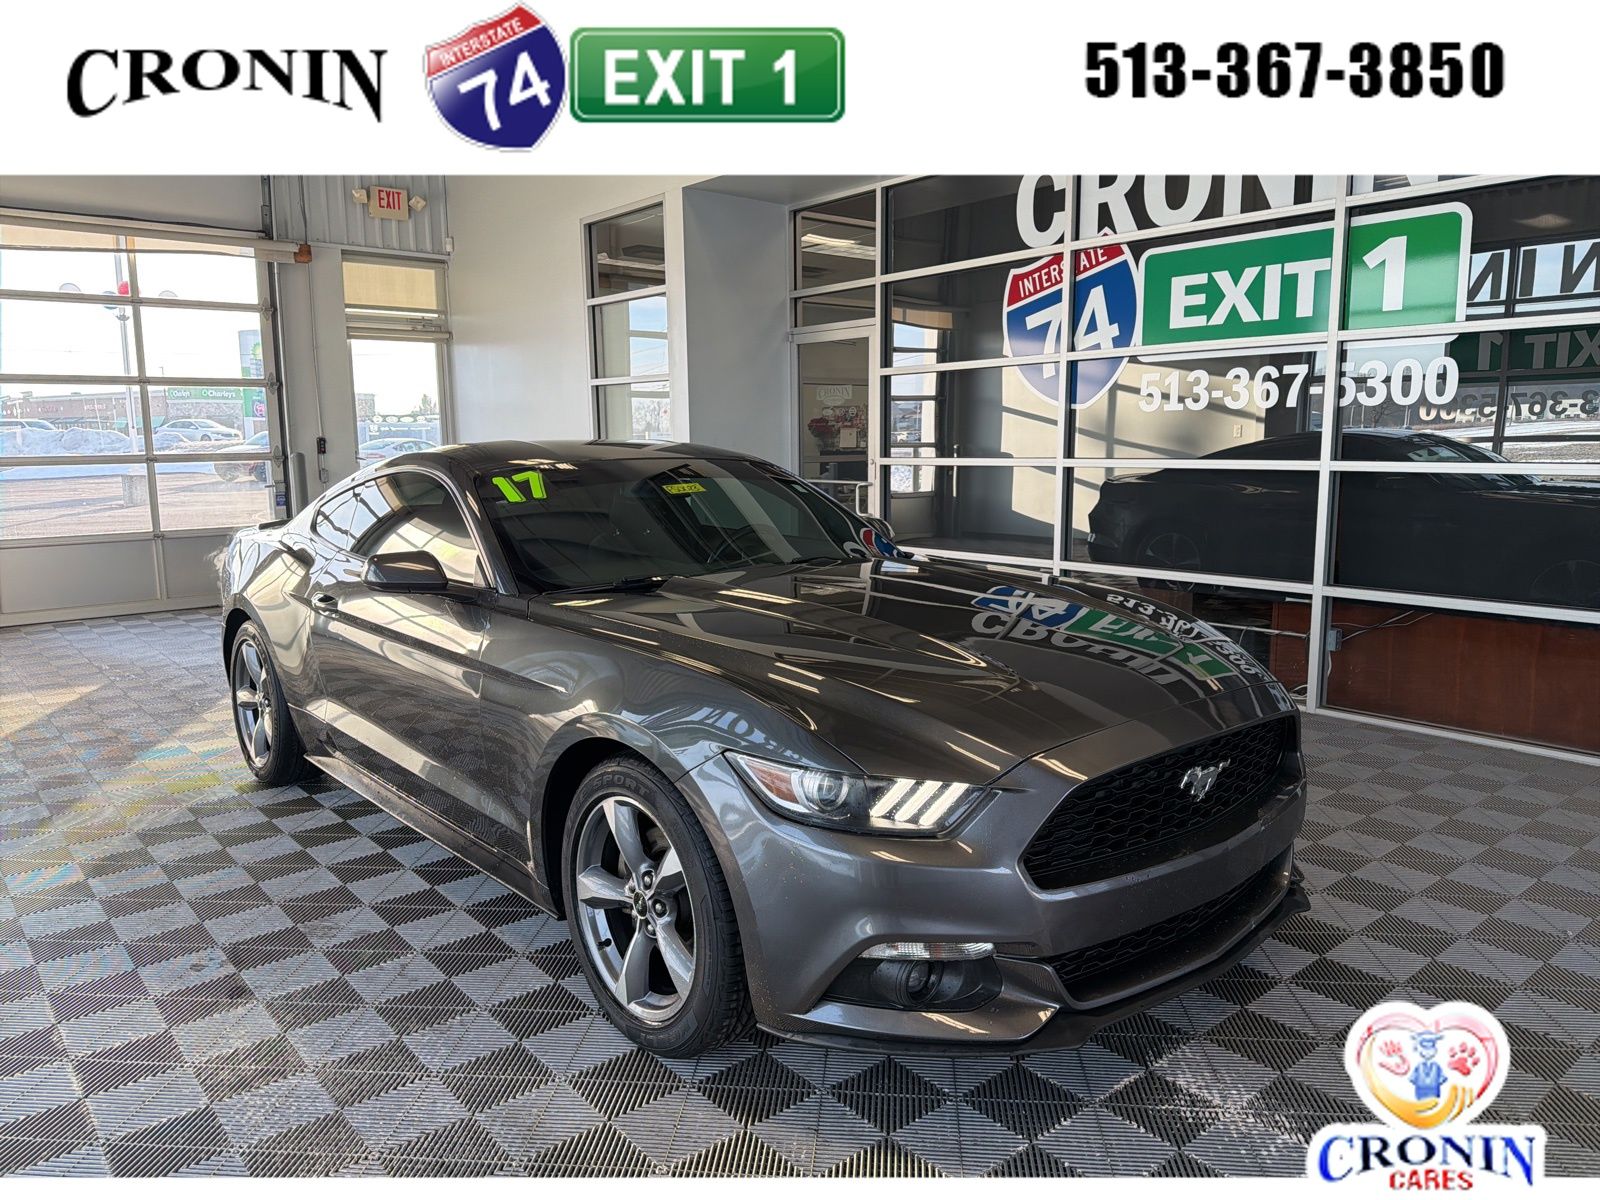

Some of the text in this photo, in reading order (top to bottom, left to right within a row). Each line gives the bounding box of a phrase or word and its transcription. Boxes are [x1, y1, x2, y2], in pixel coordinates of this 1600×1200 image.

[377, 189, 402, 211] EXIT
[1017, 175, 1438, 248] CRO
[1019, 246, 1108, 298] INTERATE
[1169, 235, 1408, 330] EXIT 1
[1025, 284, 1120, 379] 74
[1139, 356, 1460, 412] 513-367-5300
[492, 470, 547, 503] 17
